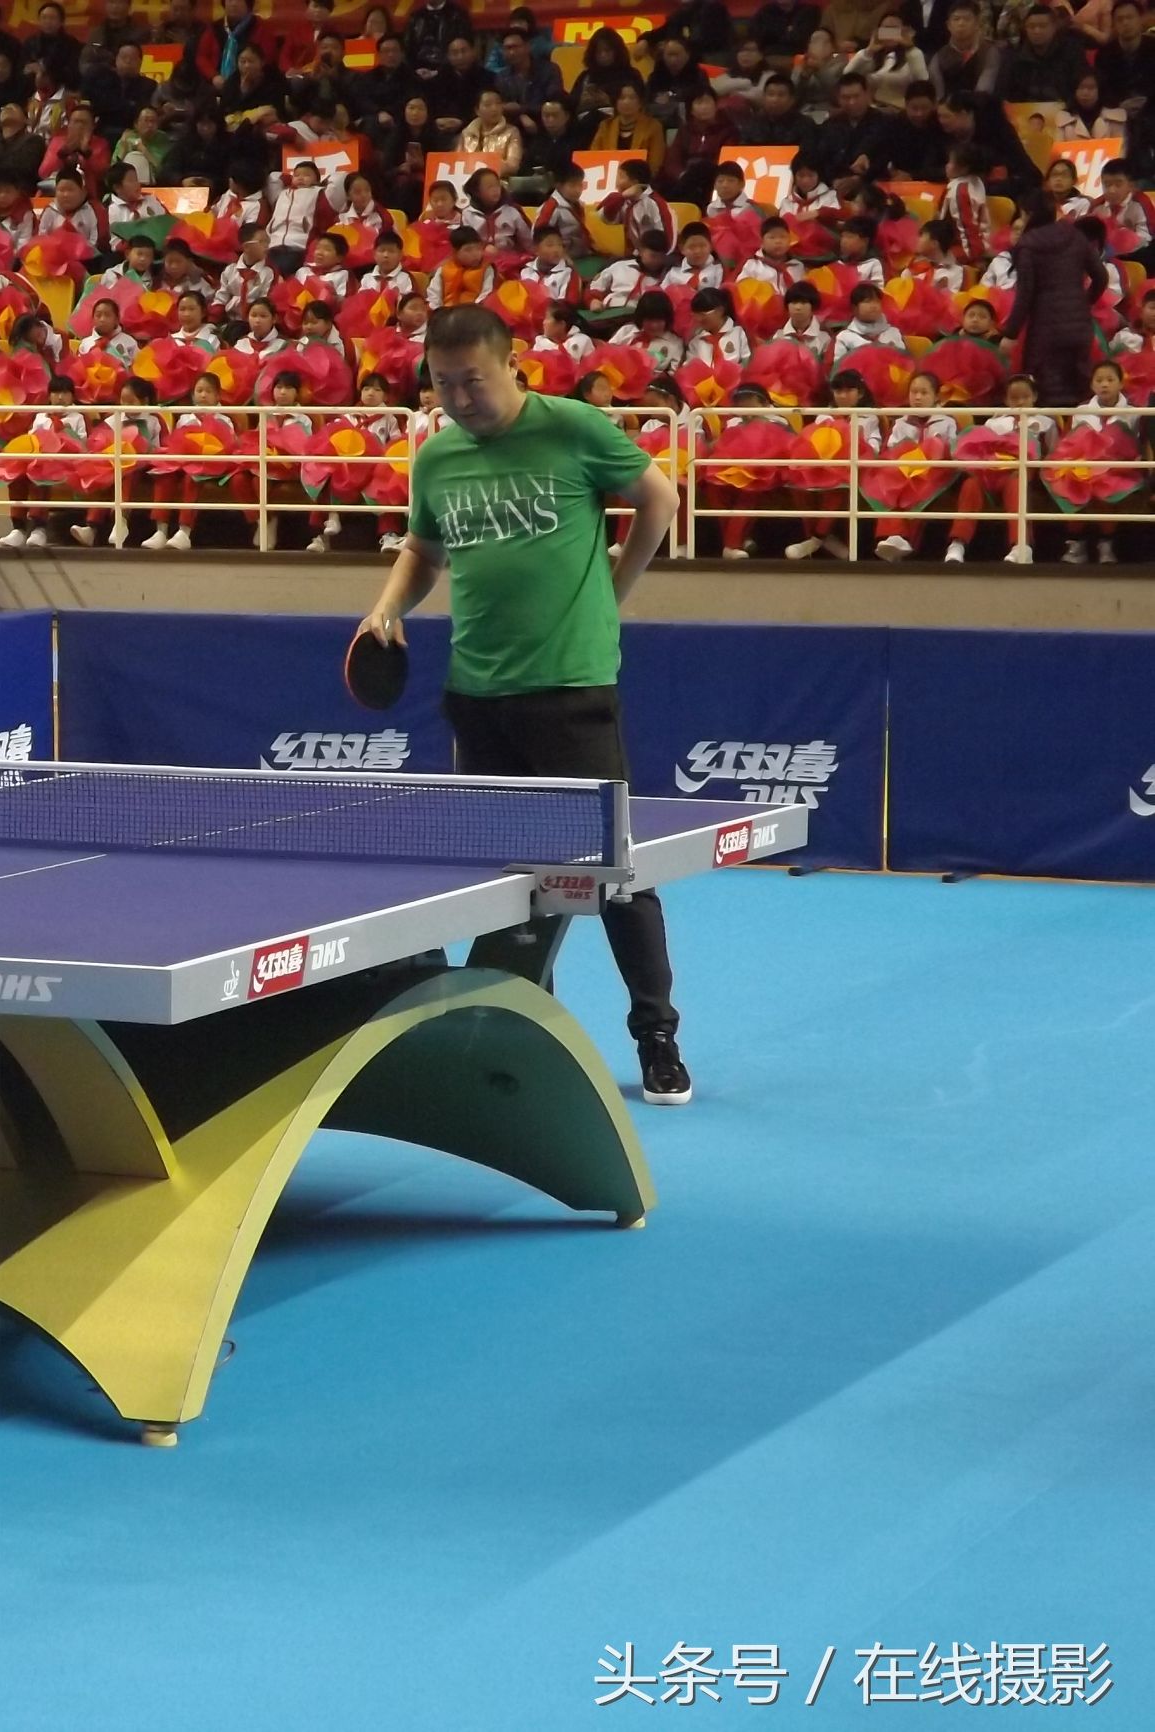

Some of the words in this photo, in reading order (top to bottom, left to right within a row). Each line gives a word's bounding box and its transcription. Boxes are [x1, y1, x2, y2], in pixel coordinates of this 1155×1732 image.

[436, 493, 559, 548] JEANS
[259, 728, 412, 771] 红双喜
[674, 739, 840, 793] 红双喜
[739, 783, 829, 810] DHS
[715, 825, 750, 865] 红双喜
[752, 823, 779, 849] DHS
[252, 942, 304, 994] 红双喜
[309, 936, 350, 971] DHS
